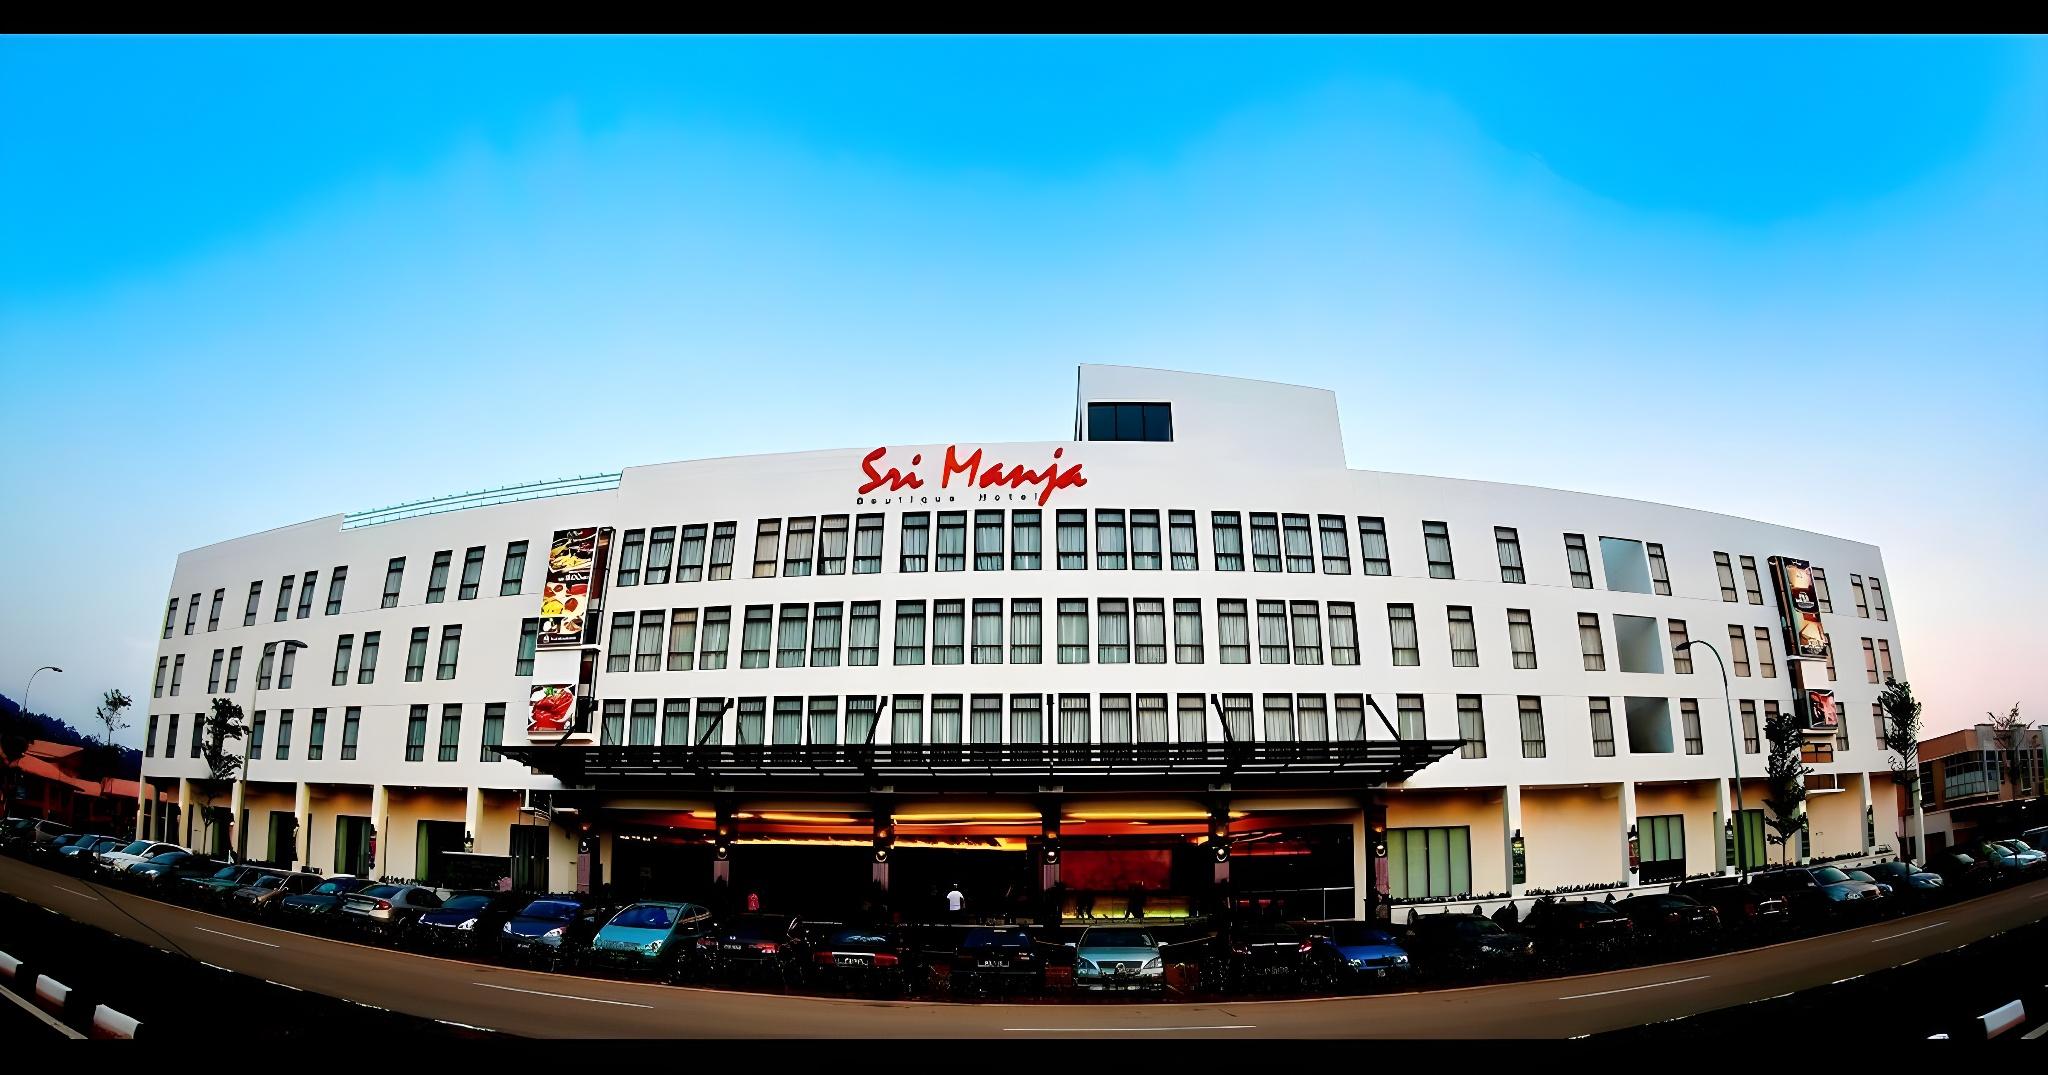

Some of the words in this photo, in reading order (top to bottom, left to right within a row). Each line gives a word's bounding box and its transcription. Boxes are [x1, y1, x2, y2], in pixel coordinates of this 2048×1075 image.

[858, 446, 924, 495] Sri
[941, 445, 1088, 506] Manja
[978, 493, 1038, 502] Hotel
